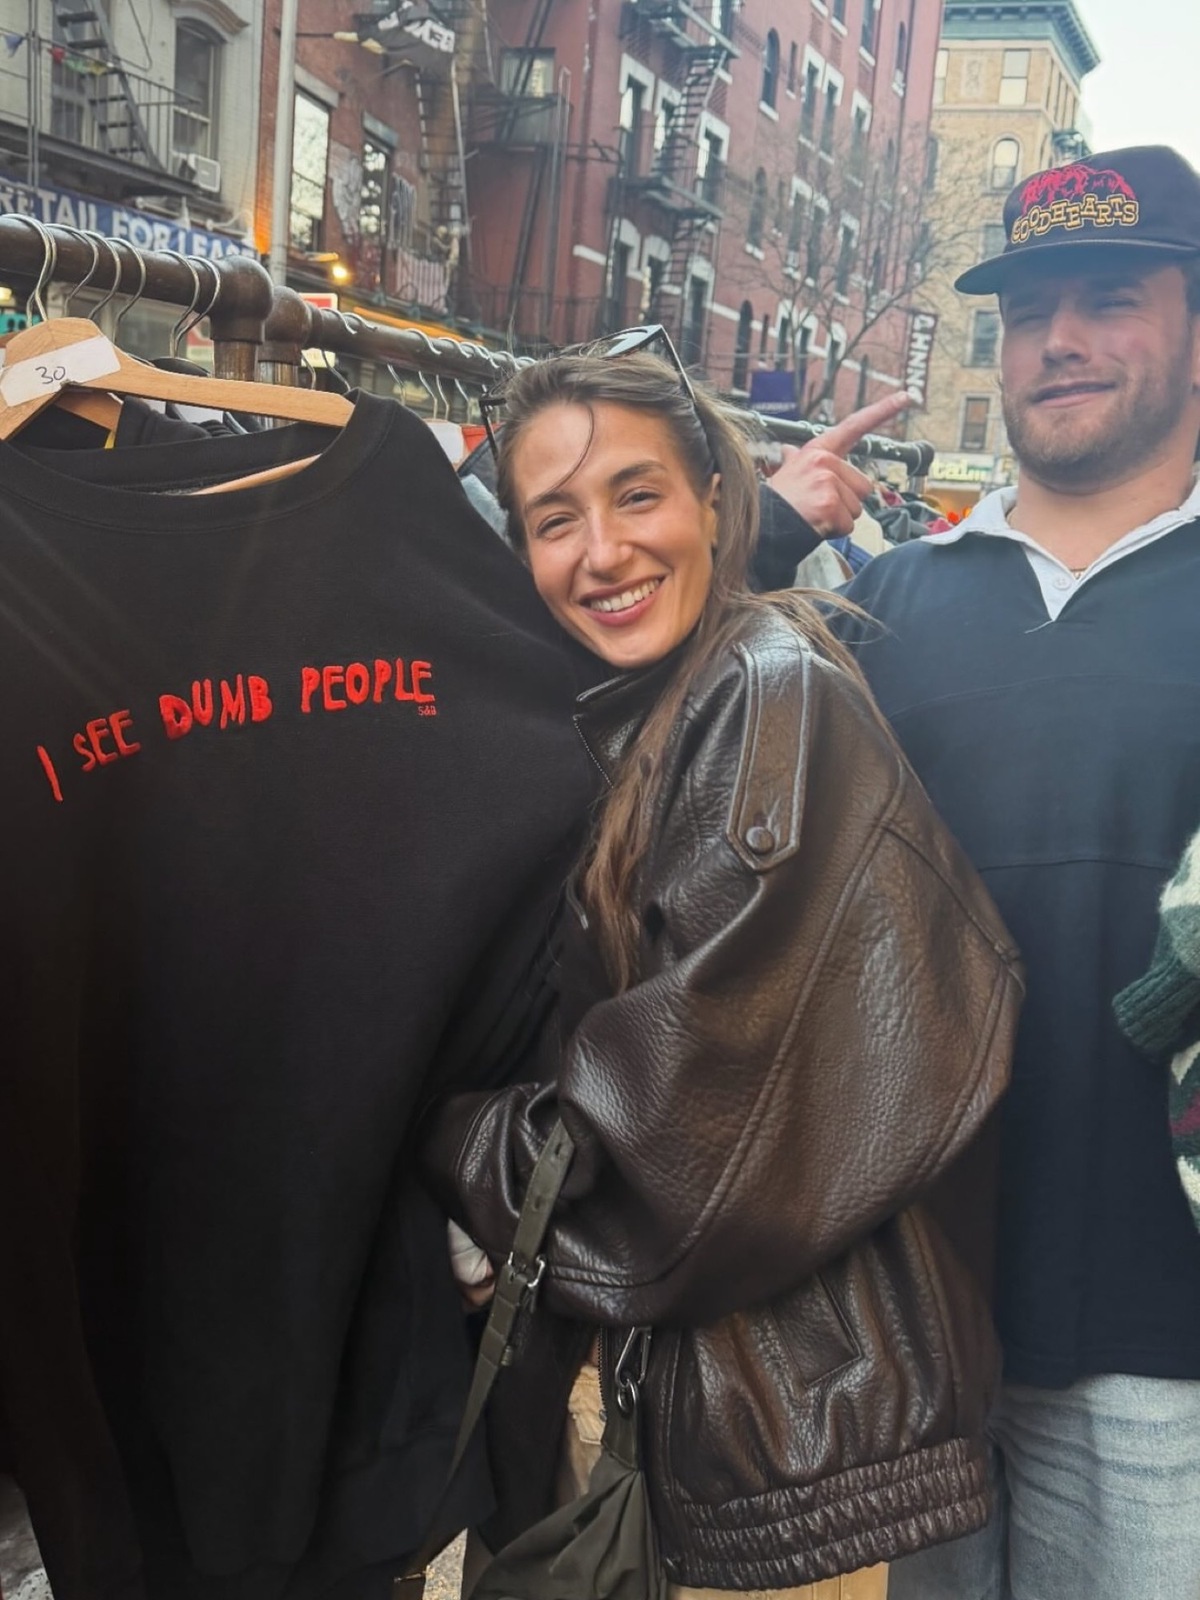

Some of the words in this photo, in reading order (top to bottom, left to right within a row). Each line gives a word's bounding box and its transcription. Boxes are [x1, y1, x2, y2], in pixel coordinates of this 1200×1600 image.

[111, 210, 171, 250] FOR
[1011, 193, 1140, 244] GOODHEARTS
[35, 366, 66, 384] 30
[37, 745, 63, 802] I
[73, 708, 141, 772] SEE
[159, 673, 273, 740] DUMB
[302, 658, 435, 713] PEOPLE
